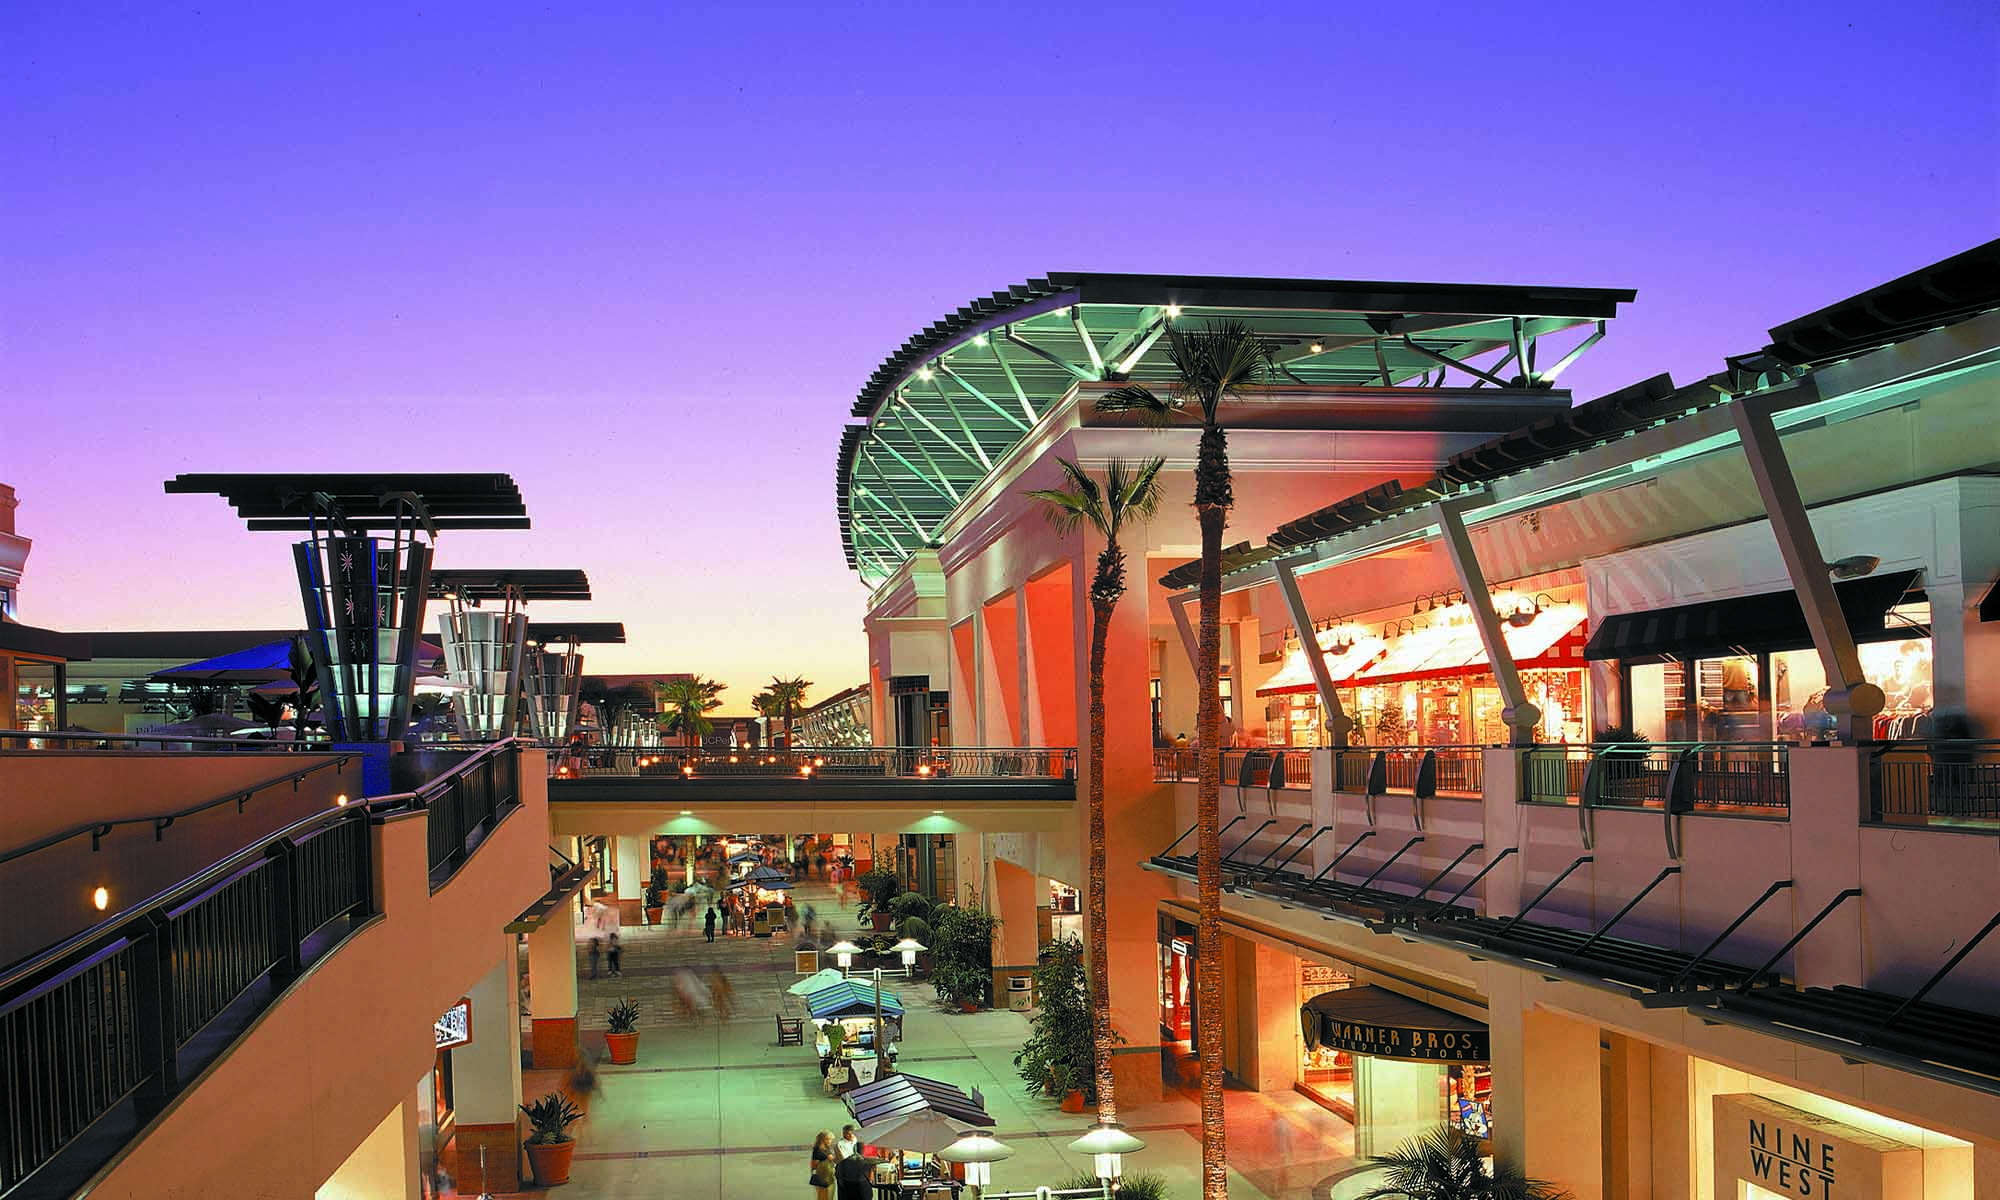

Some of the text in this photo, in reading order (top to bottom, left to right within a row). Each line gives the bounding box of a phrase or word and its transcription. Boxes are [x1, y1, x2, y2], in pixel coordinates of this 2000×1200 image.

[1331, 1021, 1400, 1046] WARNER
[1412, 1030, 1479, 1050] BROS.
[1331, 1037, 1480, 1060] STUDIO STORE
[1749, 1119, 1834, 1174] NINE
[1750, 1148, 1835, 1200] WEST
